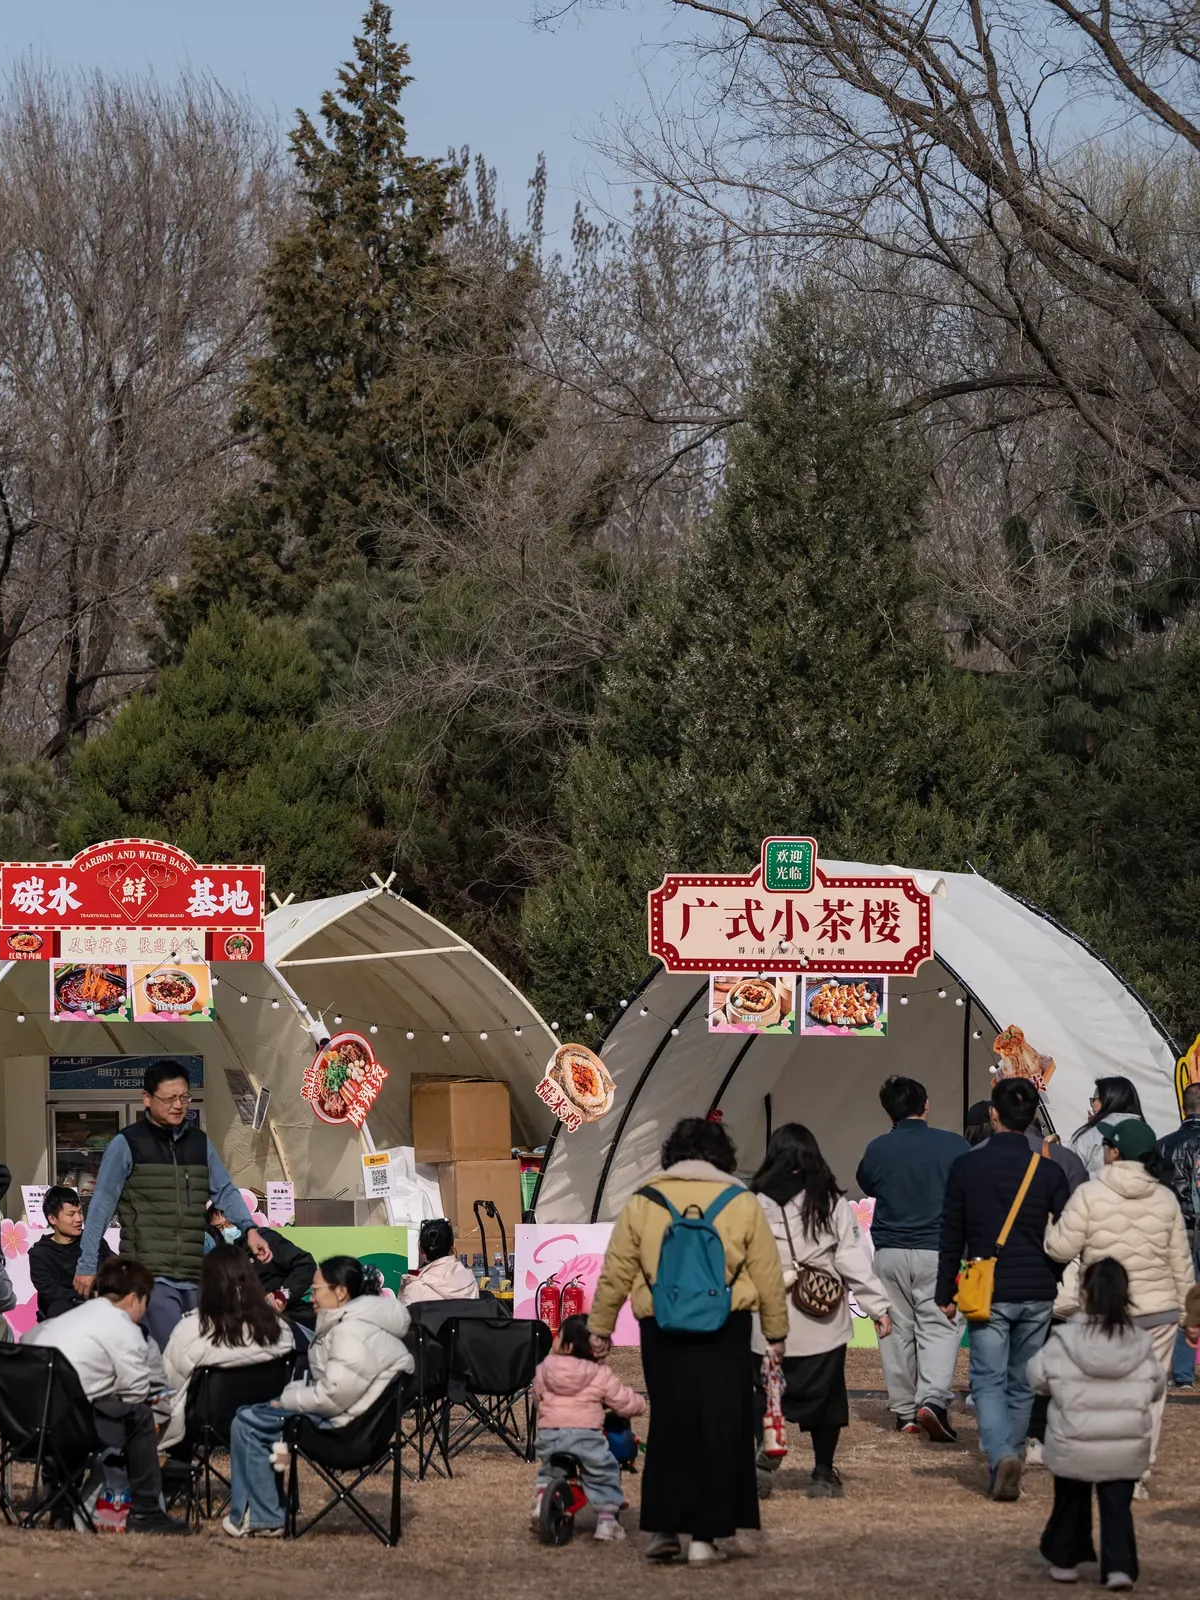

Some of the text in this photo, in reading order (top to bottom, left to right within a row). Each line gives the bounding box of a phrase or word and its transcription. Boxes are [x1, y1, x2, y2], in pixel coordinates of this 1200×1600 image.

[79, 850, 191, 875] CARBON AND WATER BASE
[775, 849, 803, 864] 欢迎
[775, 866, 803, 881] 光临
[9, 876, 83, 916] 碳水
[185, 877, 254, 918] 基地
[679, 897, 902, 945] 广式小茶楼
[113, 1078, 145, 1087] FRESH
[346, 1063, 389, 1129] 麻辣烫
[536, 1078, 582, 1132] 糯米鸡
